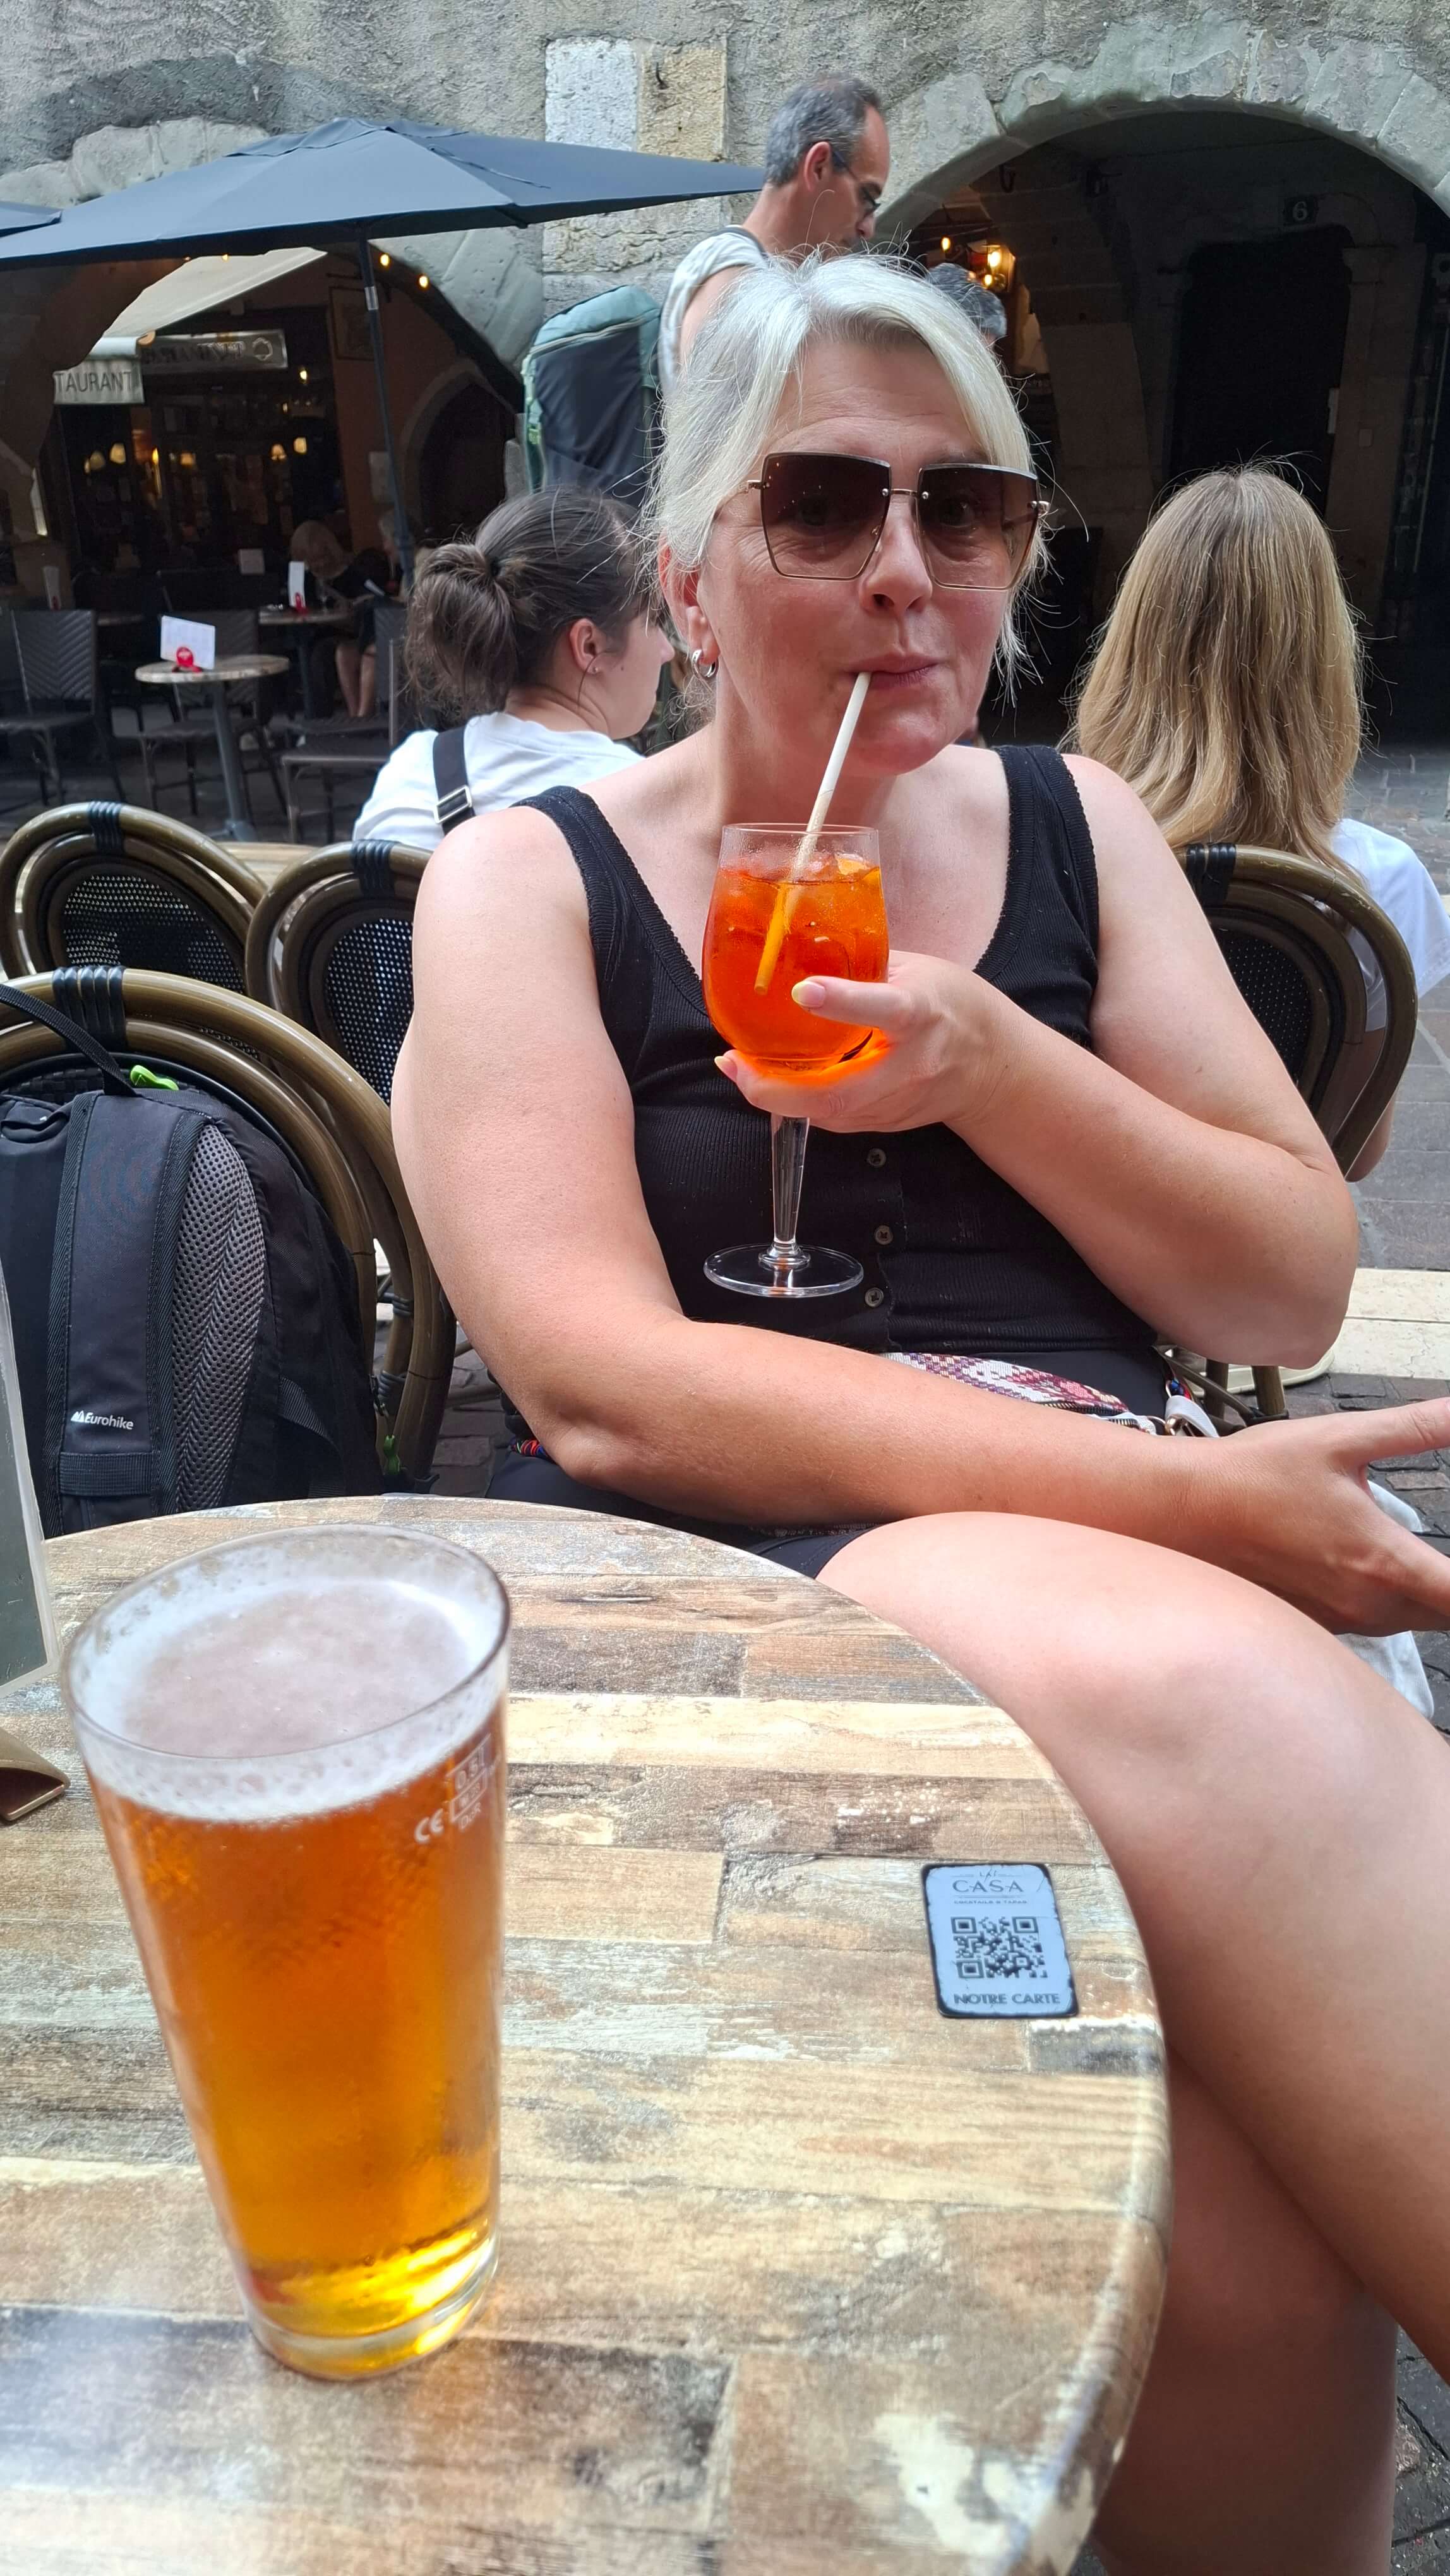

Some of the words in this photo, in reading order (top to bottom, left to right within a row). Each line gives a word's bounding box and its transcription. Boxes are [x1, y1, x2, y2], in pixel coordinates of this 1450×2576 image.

[1293, 201, 1309, 221] 6
[54, 371, 133, 393] TAURANT
[85, 1412, 134, 1430] Eurohike
[952, 1879, 1024, 1892] CASA
[954, 1993, 1008, 2005] NOTRE
[1012, 1993, 1061, 2005] CARTE
